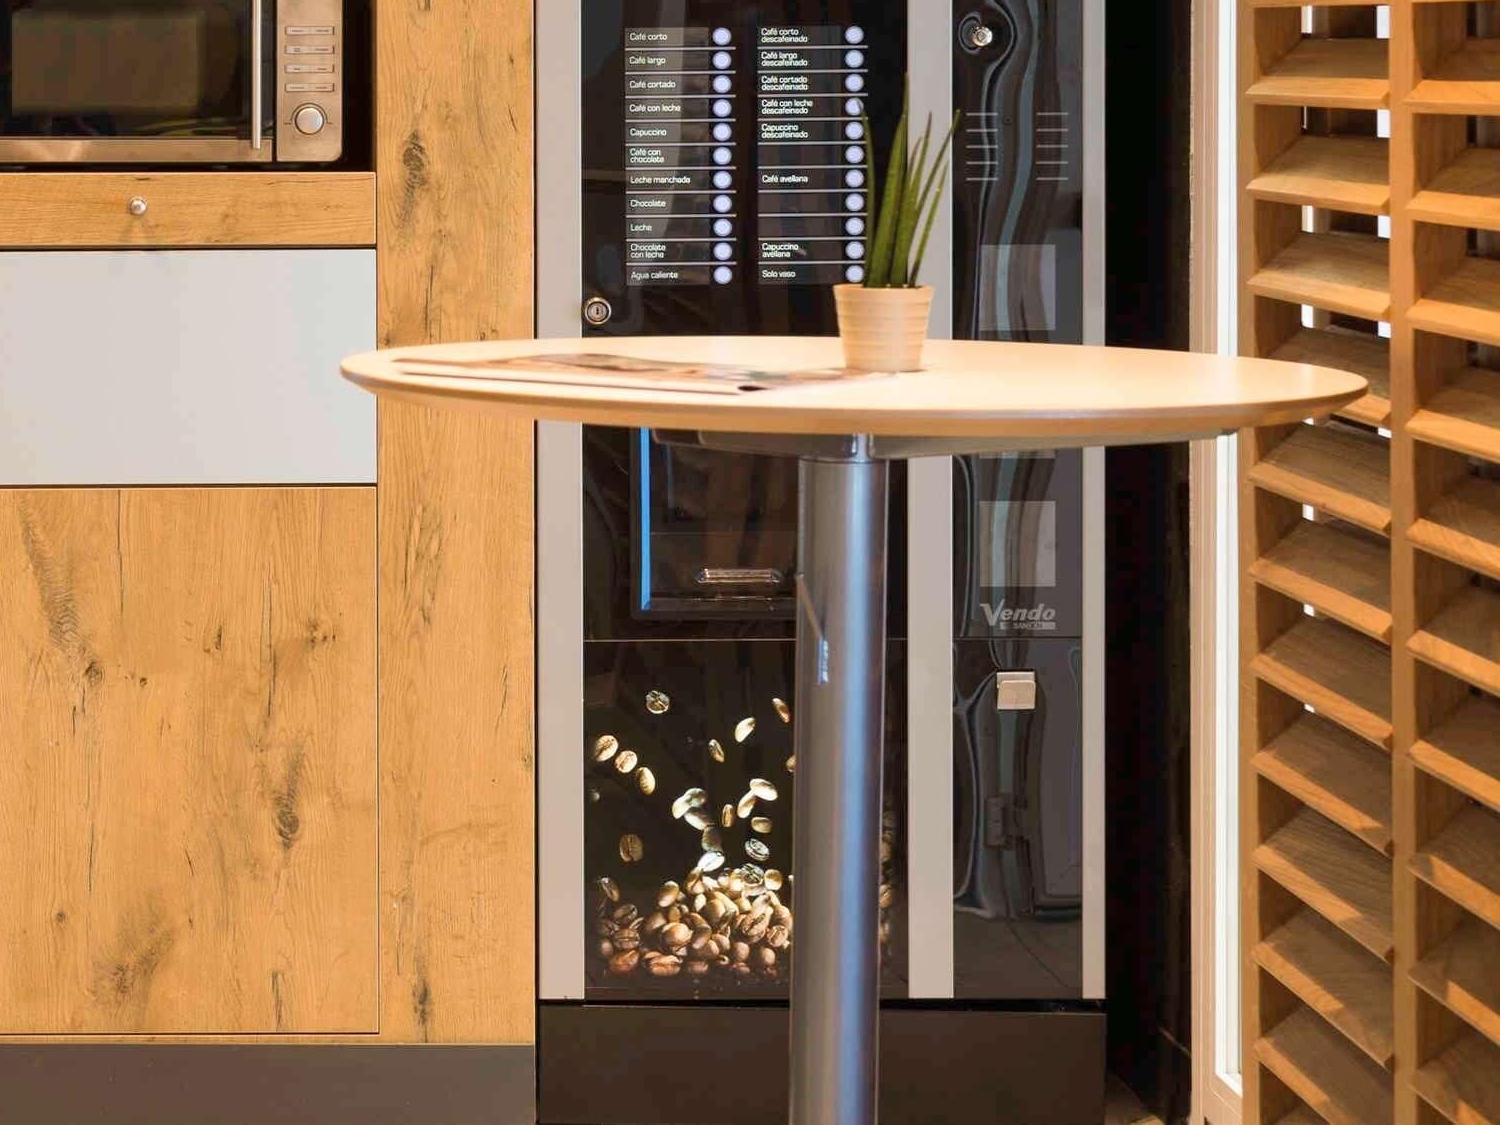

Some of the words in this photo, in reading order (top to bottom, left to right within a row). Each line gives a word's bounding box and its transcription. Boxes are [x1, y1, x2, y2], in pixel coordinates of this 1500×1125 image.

[648, 57, 666, 65] largo
[762, 270, 778, 278] Solo
[980, 598, 1056, 627] Vendo
